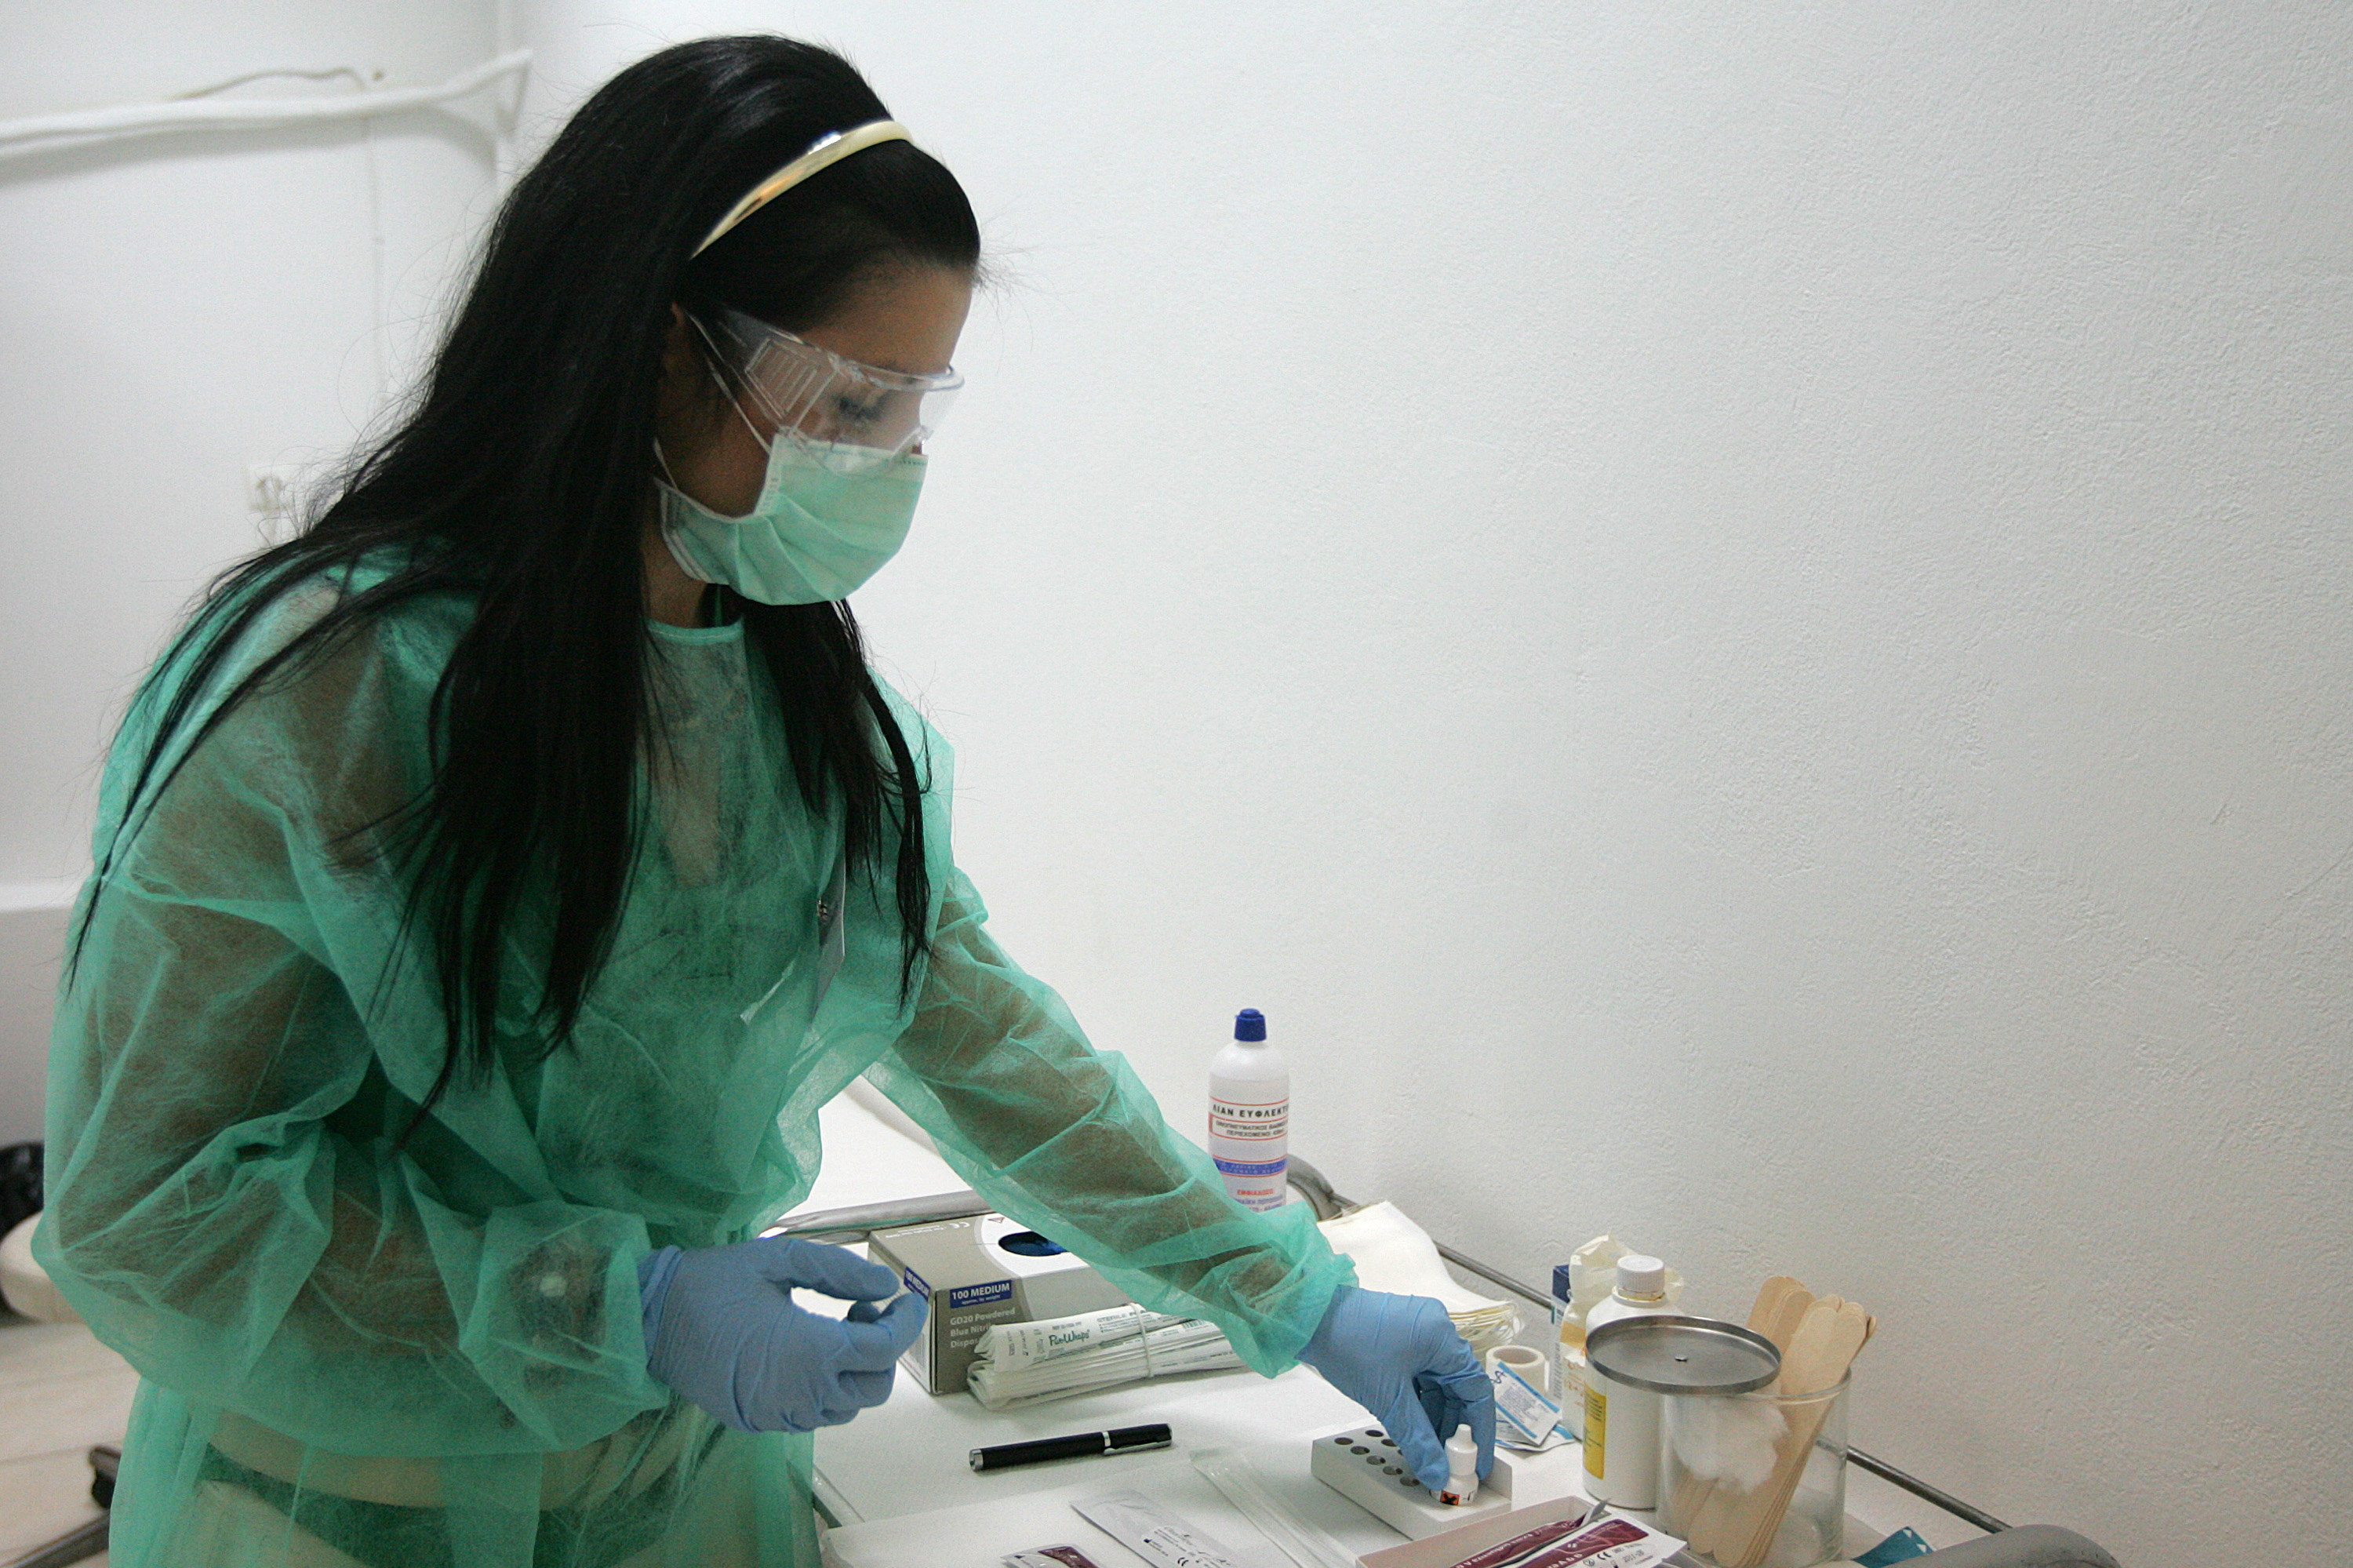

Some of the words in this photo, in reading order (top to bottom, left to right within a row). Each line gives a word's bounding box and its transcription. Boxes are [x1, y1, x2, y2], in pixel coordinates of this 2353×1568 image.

[951, 1290, 969, 1300] 100
[971, 1282, 1010, 1297] MEDIUM
[950, 1316, 973, 1326] GD20
[975, 1308, 1016, 1321] Powdered
[951, 1328, 969, 1337] Blue
